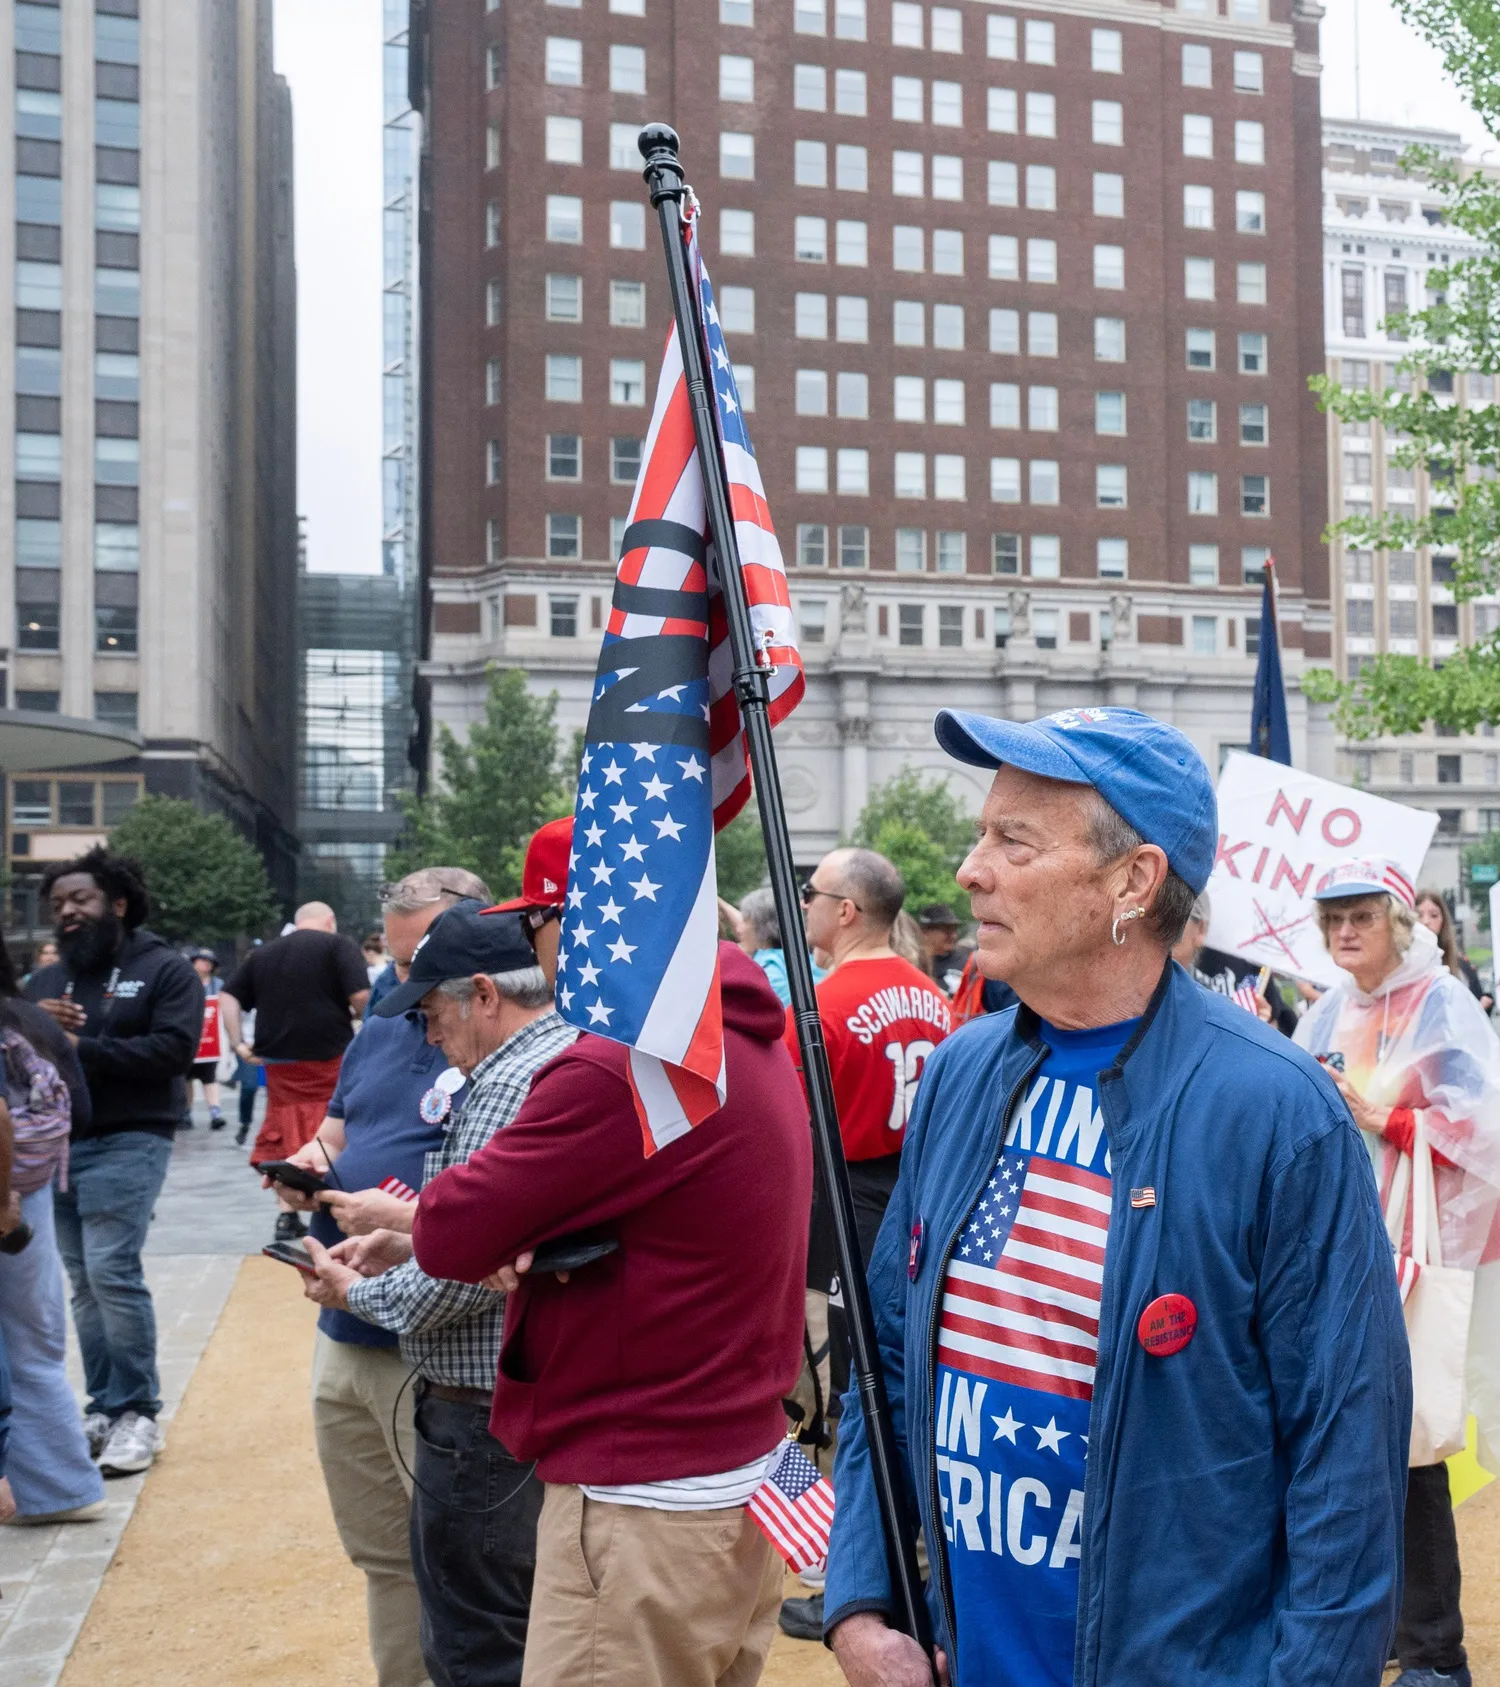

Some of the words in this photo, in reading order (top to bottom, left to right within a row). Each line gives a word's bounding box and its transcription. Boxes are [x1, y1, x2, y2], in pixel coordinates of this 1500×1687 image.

[1265, 788, 1362, 848] NO
[1213, 833, 1330, 900] KIN
[846, 985, 951, 1044] SCHWARBER
[1004, 1075, 1111, 1175] KIN
[1150, 1317, 1165, 1332] AM
[1169, 1311, 1186, 1325] THE
[936, 1371, 988, 1458] IN
[936, 1453, 1085, 1569] ERICA
